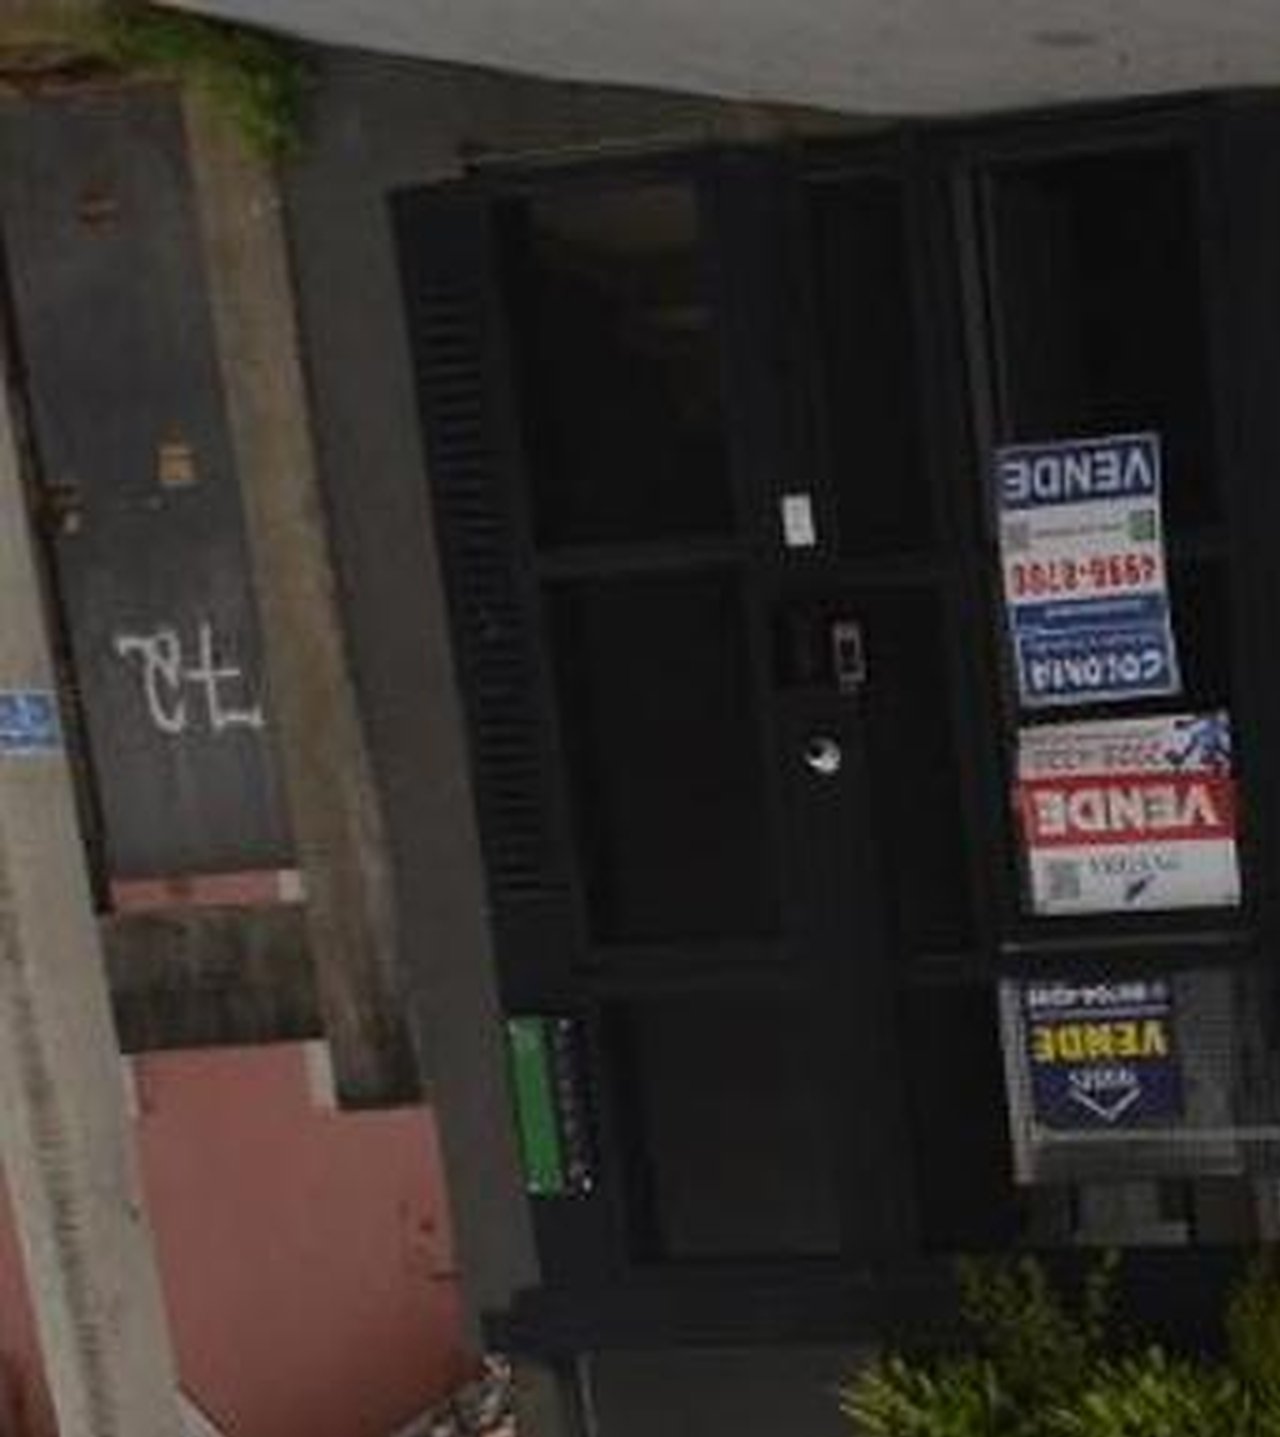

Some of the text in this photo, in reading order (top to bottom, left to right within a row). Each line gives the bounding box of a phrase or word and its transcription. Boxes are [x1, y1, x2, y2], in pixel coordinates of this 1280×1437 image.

[999, 448, 1154, 501] VENDE
[112, 622, 266, 733] 72
[1032, 782, 1219, 837] VENDE
[1032, 1020, 1171, 1063] VENDE
